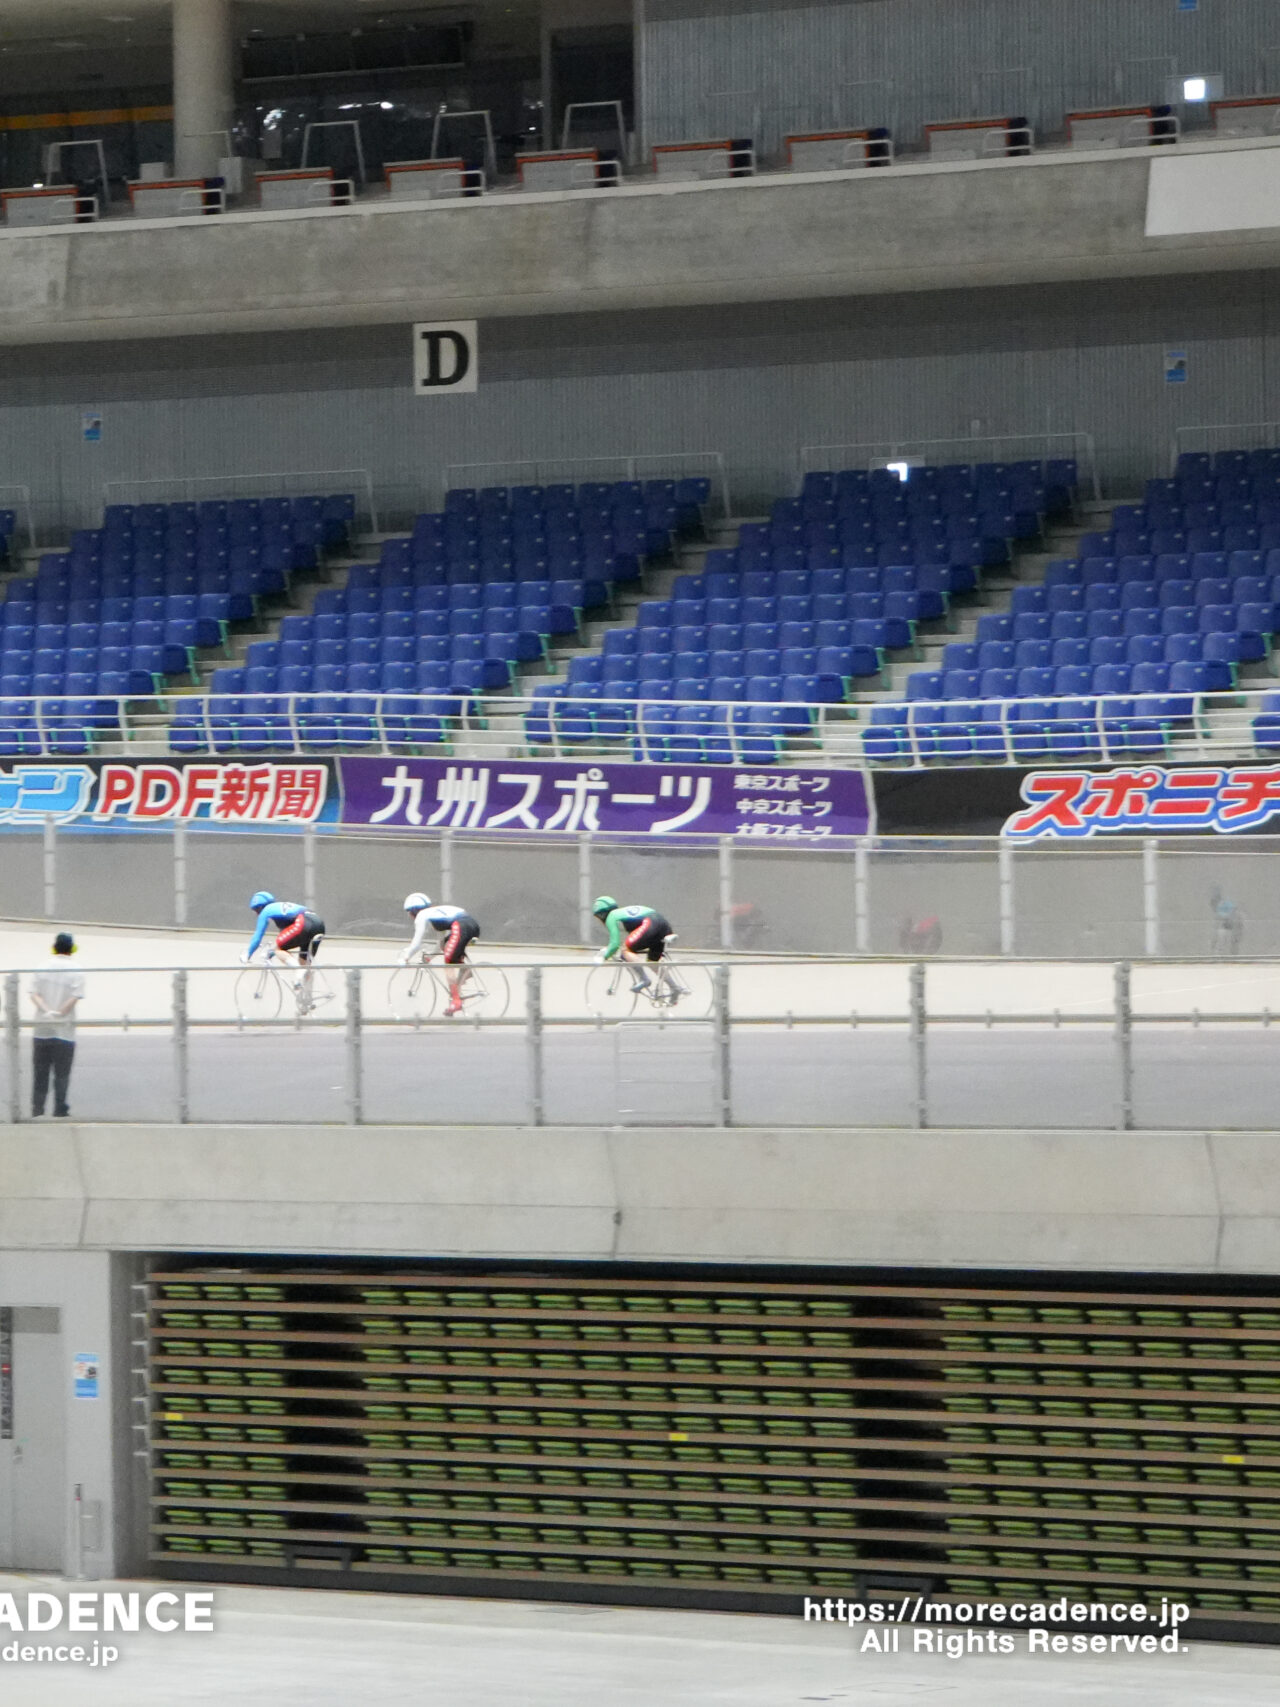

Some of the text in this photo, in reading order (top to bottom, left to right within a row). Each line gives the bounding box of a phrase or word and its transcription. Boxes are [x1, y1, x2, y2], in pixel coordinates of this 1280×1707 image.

[421, 330, 469, 386] D
[370, 765, 712, 833] 九州スポーツ
